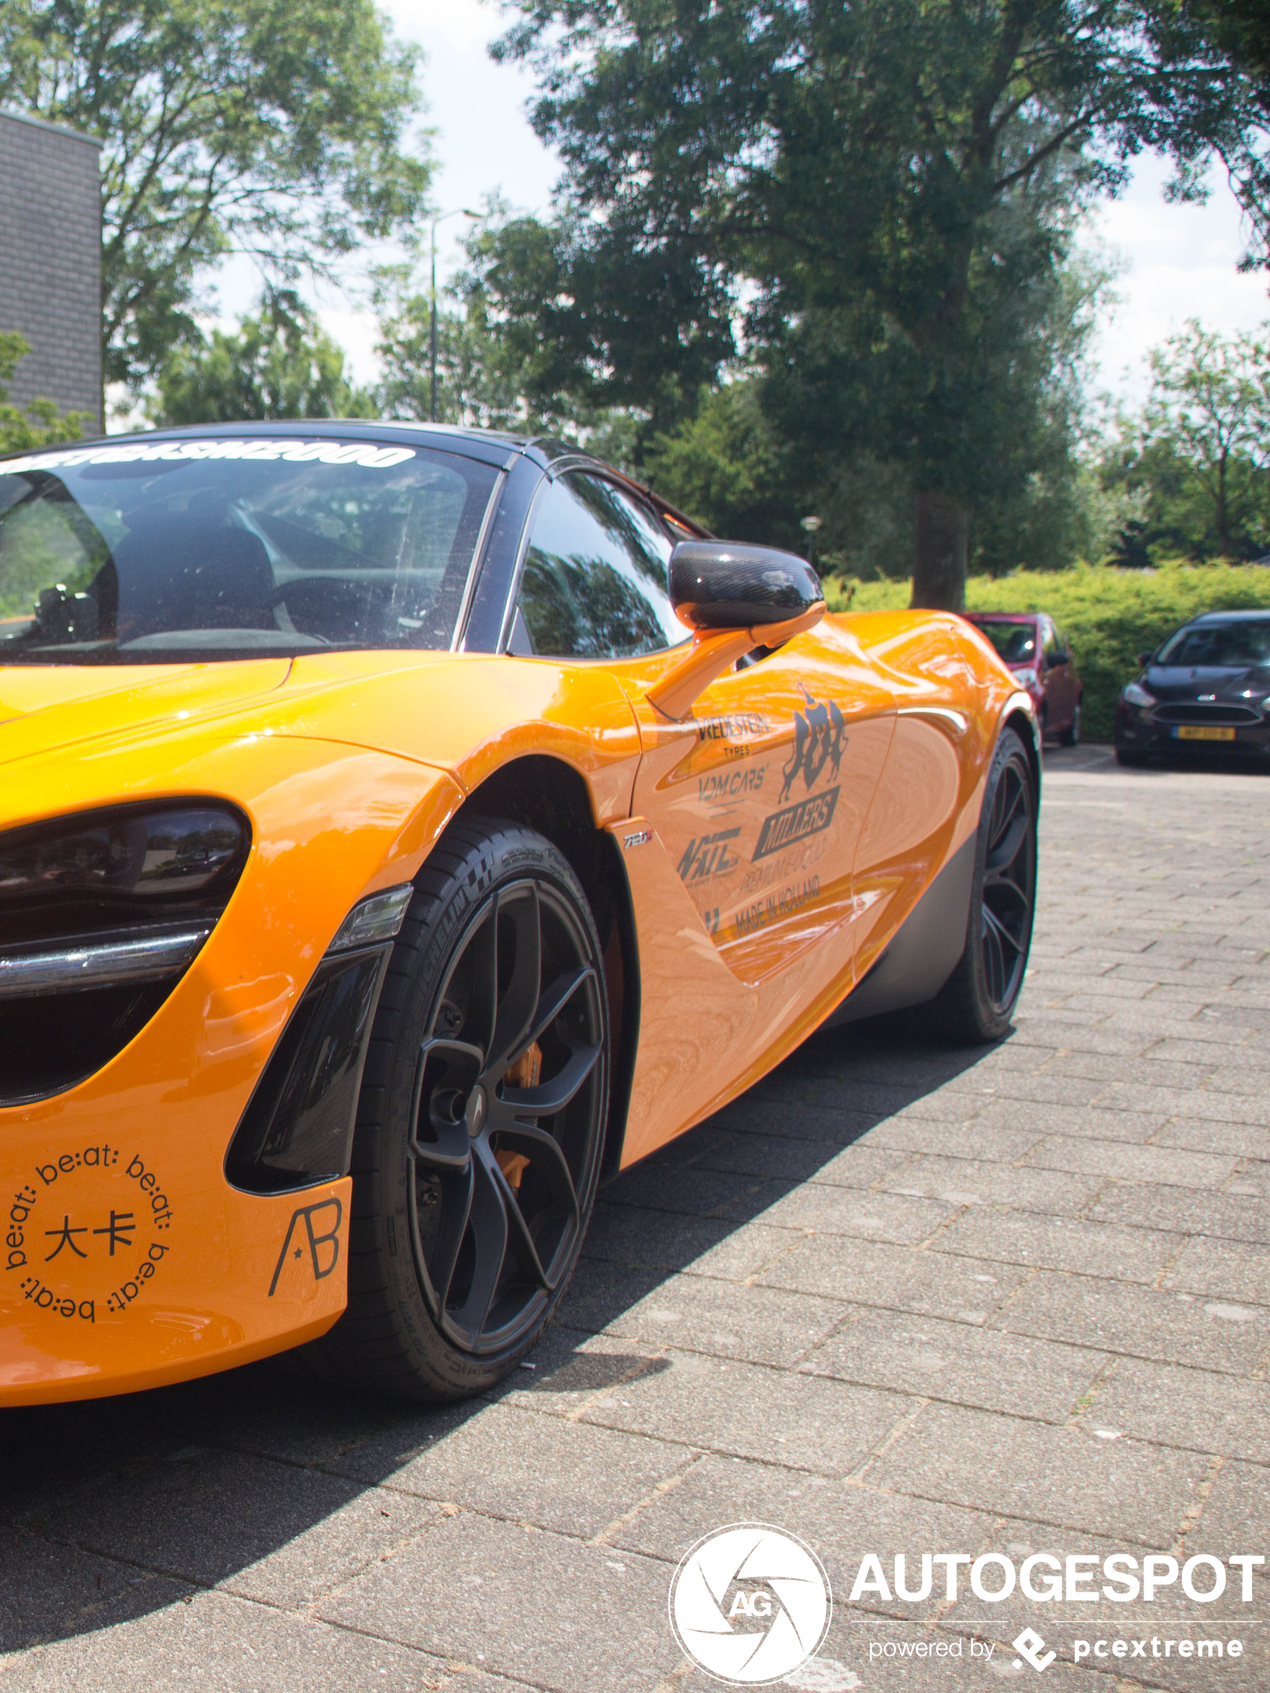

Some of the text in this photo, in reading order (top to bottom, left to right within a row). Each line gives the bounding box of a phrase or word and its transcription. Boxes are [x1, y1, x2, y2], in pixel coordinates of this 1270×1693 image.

[695, 713, 770, 741] VREDESTEIN
[723, 745, 751, 758] TYRES
[760, 796, 831, 854] MILLERS
[735, 901, 766, 938] MADE
[766, 893, 778, 922] IN
[778, 874, 821, 917] HOLLAND
[5, 1144, 170, 1323] be:at: be:at: be:at: be:at: be:at:
[44, 1210, 136, 1263] 大卡
